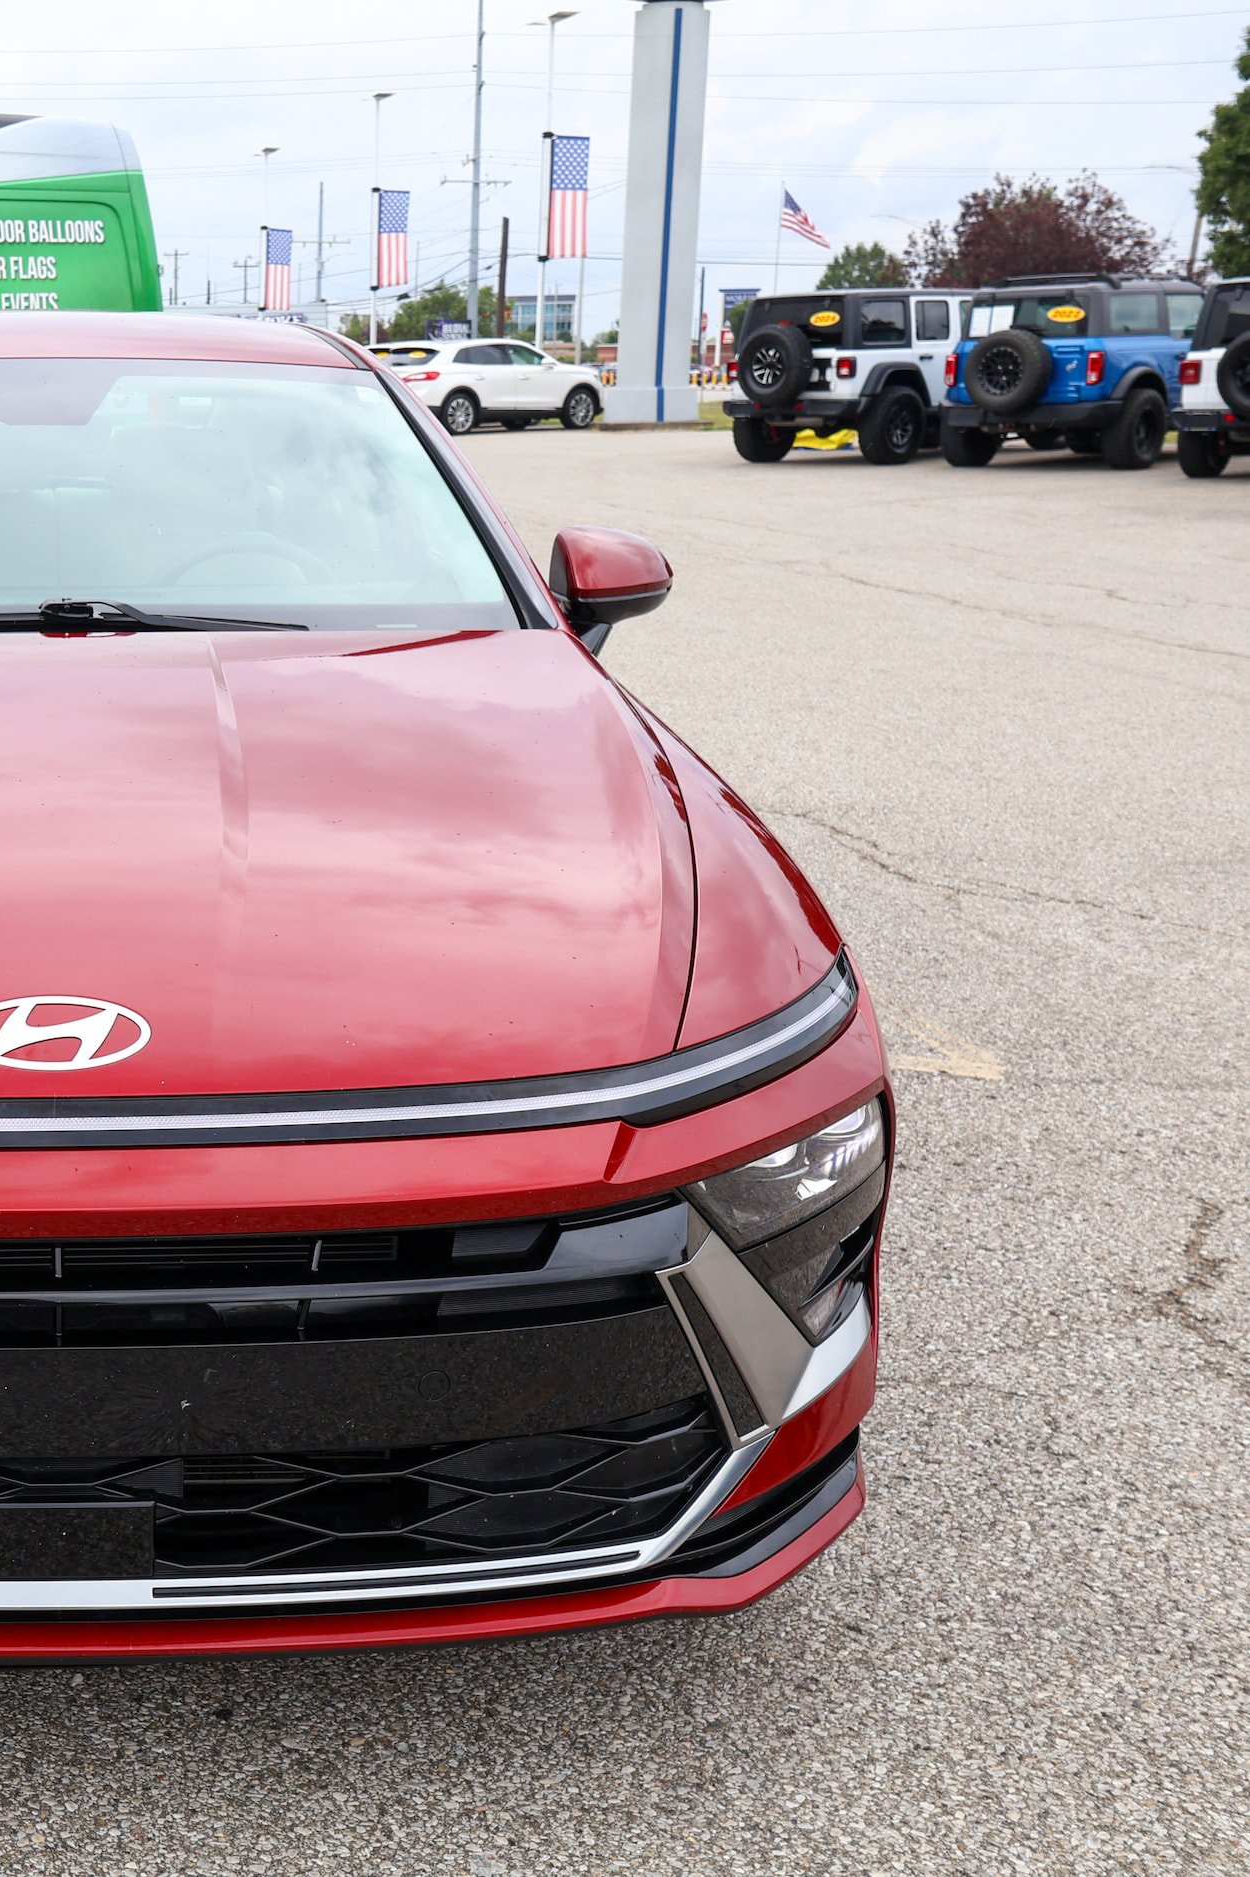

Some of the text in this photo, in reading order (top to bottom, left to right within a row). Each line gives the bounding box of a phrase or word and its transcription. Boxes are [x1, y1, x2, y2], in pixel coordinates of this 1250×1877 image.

[28, 220, 105, 244] BALLOONS
[10, 256, 57, 280] FLAGS
[1, 293, 58, 311] EVENTS
